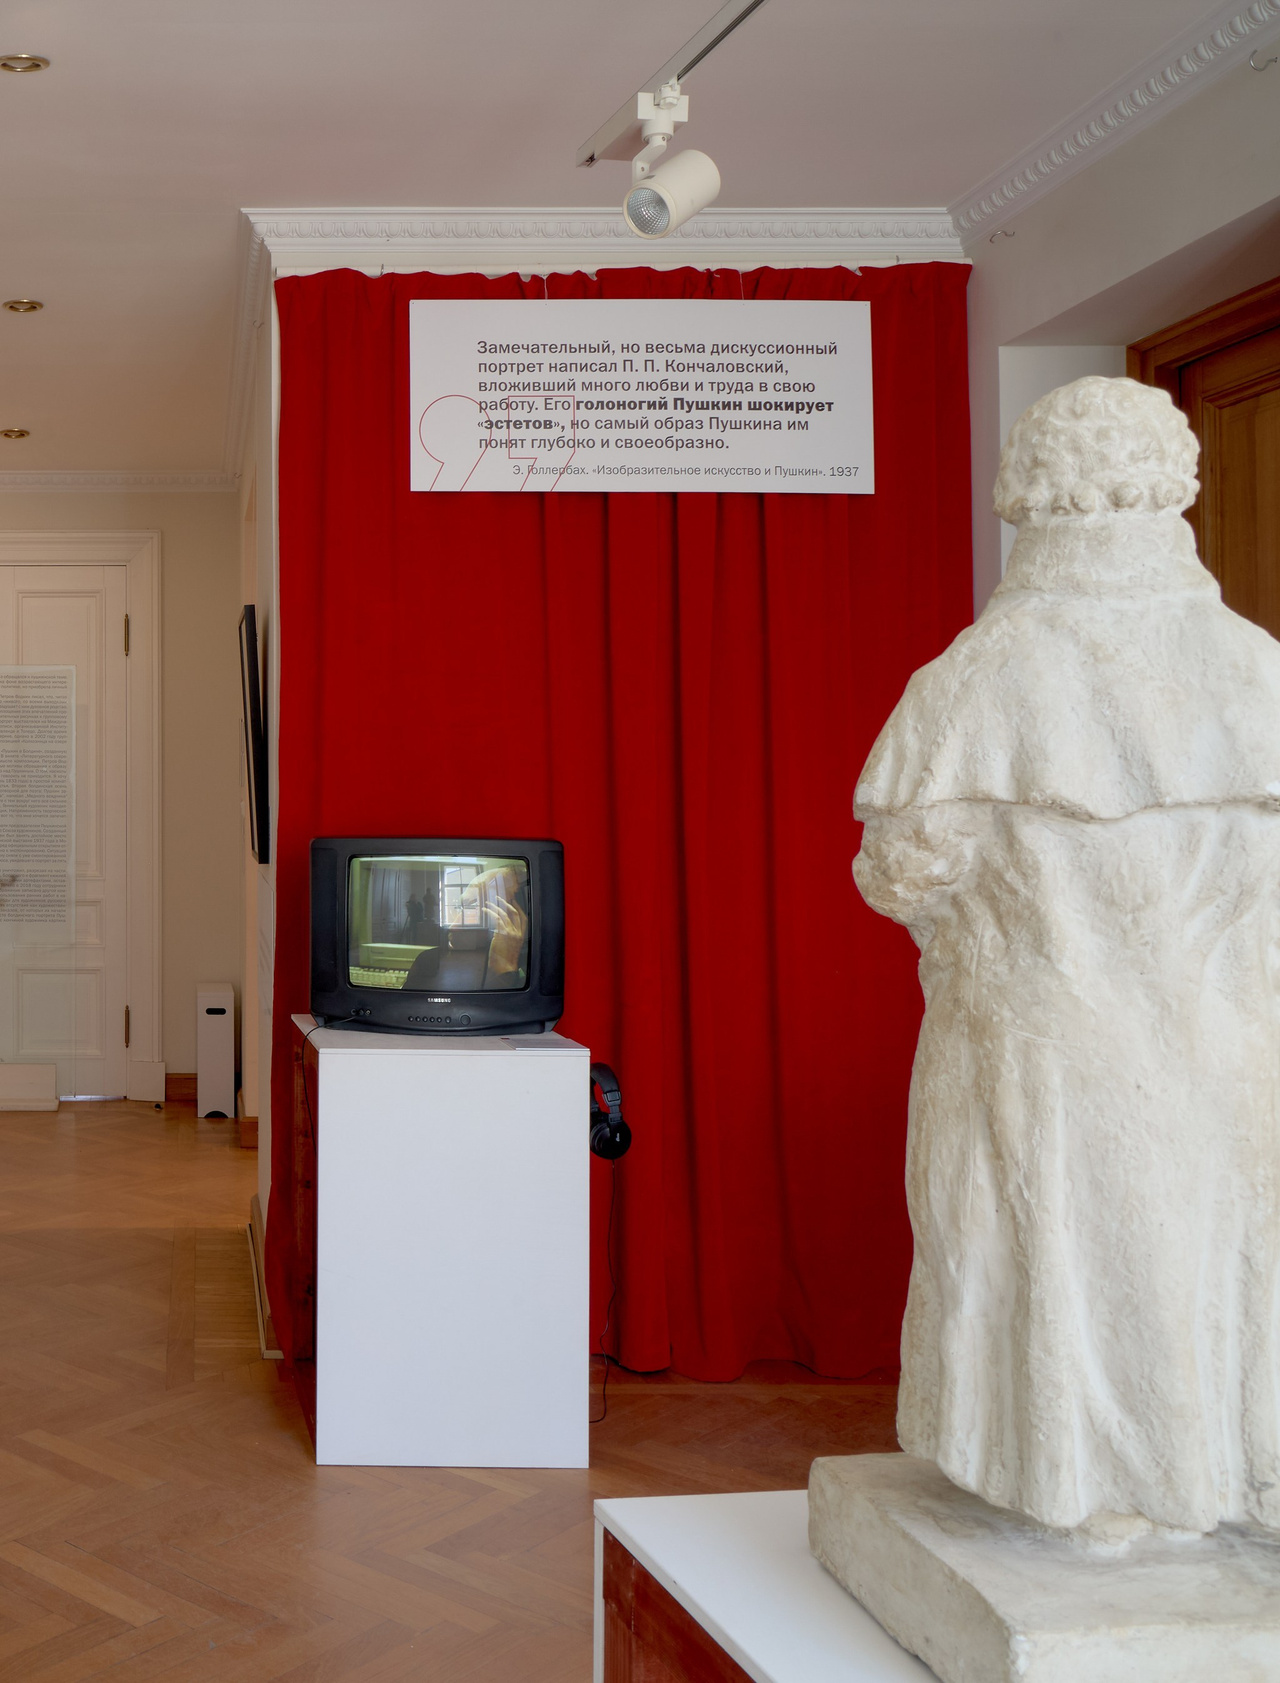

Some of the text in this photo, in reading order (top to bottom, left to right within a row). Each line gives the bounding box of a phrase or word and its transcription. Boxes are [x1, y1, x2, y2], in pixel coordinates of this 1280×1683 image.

[478, 340, 837, 357] Замечательный, но весьма дискуссионный
[479, 359, 788, 375] портрет написал П. П. Кончаловский,
[479, 378, 815, 394] вложивший много любви и труда в свою
[479, 398, 834, 414] работу. Его голоногий Пушкин шокирует
[478, 416, 808, 432] «эстетов», но самый образ Пушкина им
[480, 436, 729, 452] понят глубоко и своеобразно.
[513, 465, 523, 475] Э.
[593, 465, 701, 476] «Изобразительное
[705, 468, 761, 477] искусство
[775, 466, 825, 478] Пушкин».
[830, 467, 858, 476] 1937
